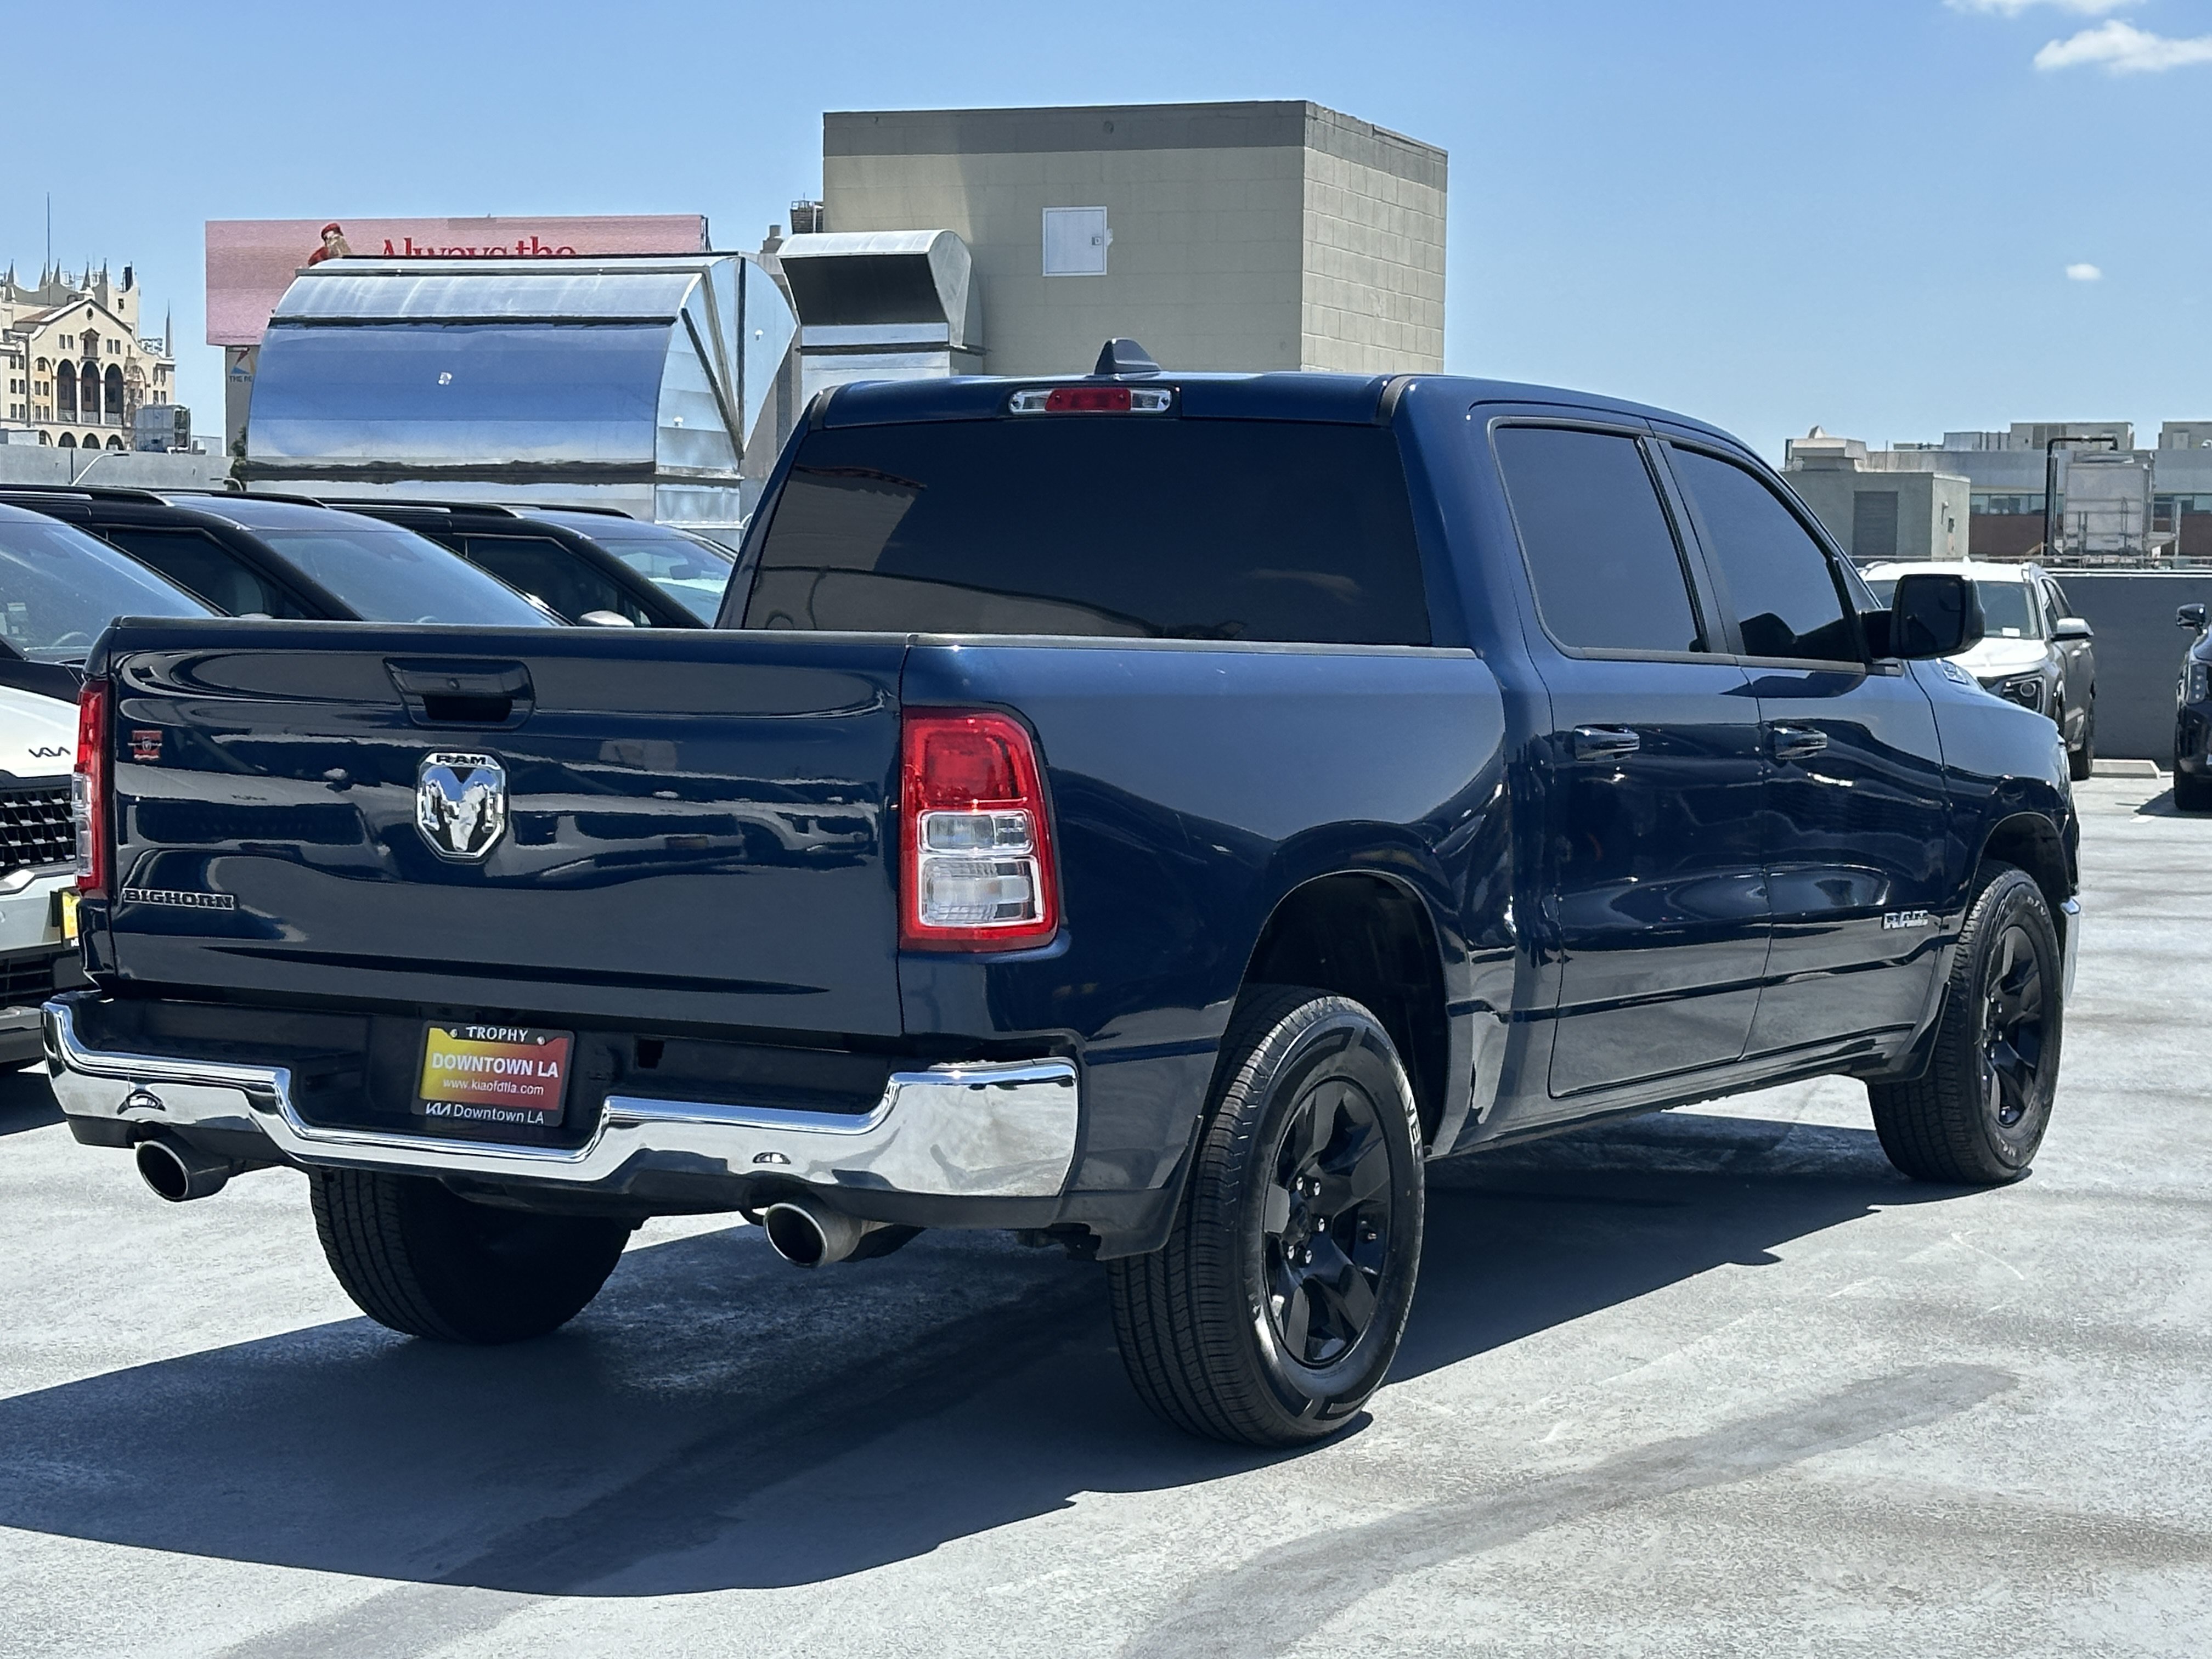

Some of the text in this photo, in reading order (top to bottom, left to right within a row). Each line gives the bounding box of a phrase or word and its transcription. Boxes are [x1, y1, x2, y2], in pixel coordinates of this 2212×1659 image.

[436, 754, 486, 765] RAM
[122, 888, 235, 911] BIGHORN
[1883, 910, 1928, 930] RAM
[466, 1026, 528, 1042] TROPHY
[432, 1053, 558, 1078] DOWNTOWN LA
[443, 1079, 544, 1096] www.kiaofdtla.com
[454, 1104, 524, 1123] Downtown
[527, 1110, 544, 1124] LA
